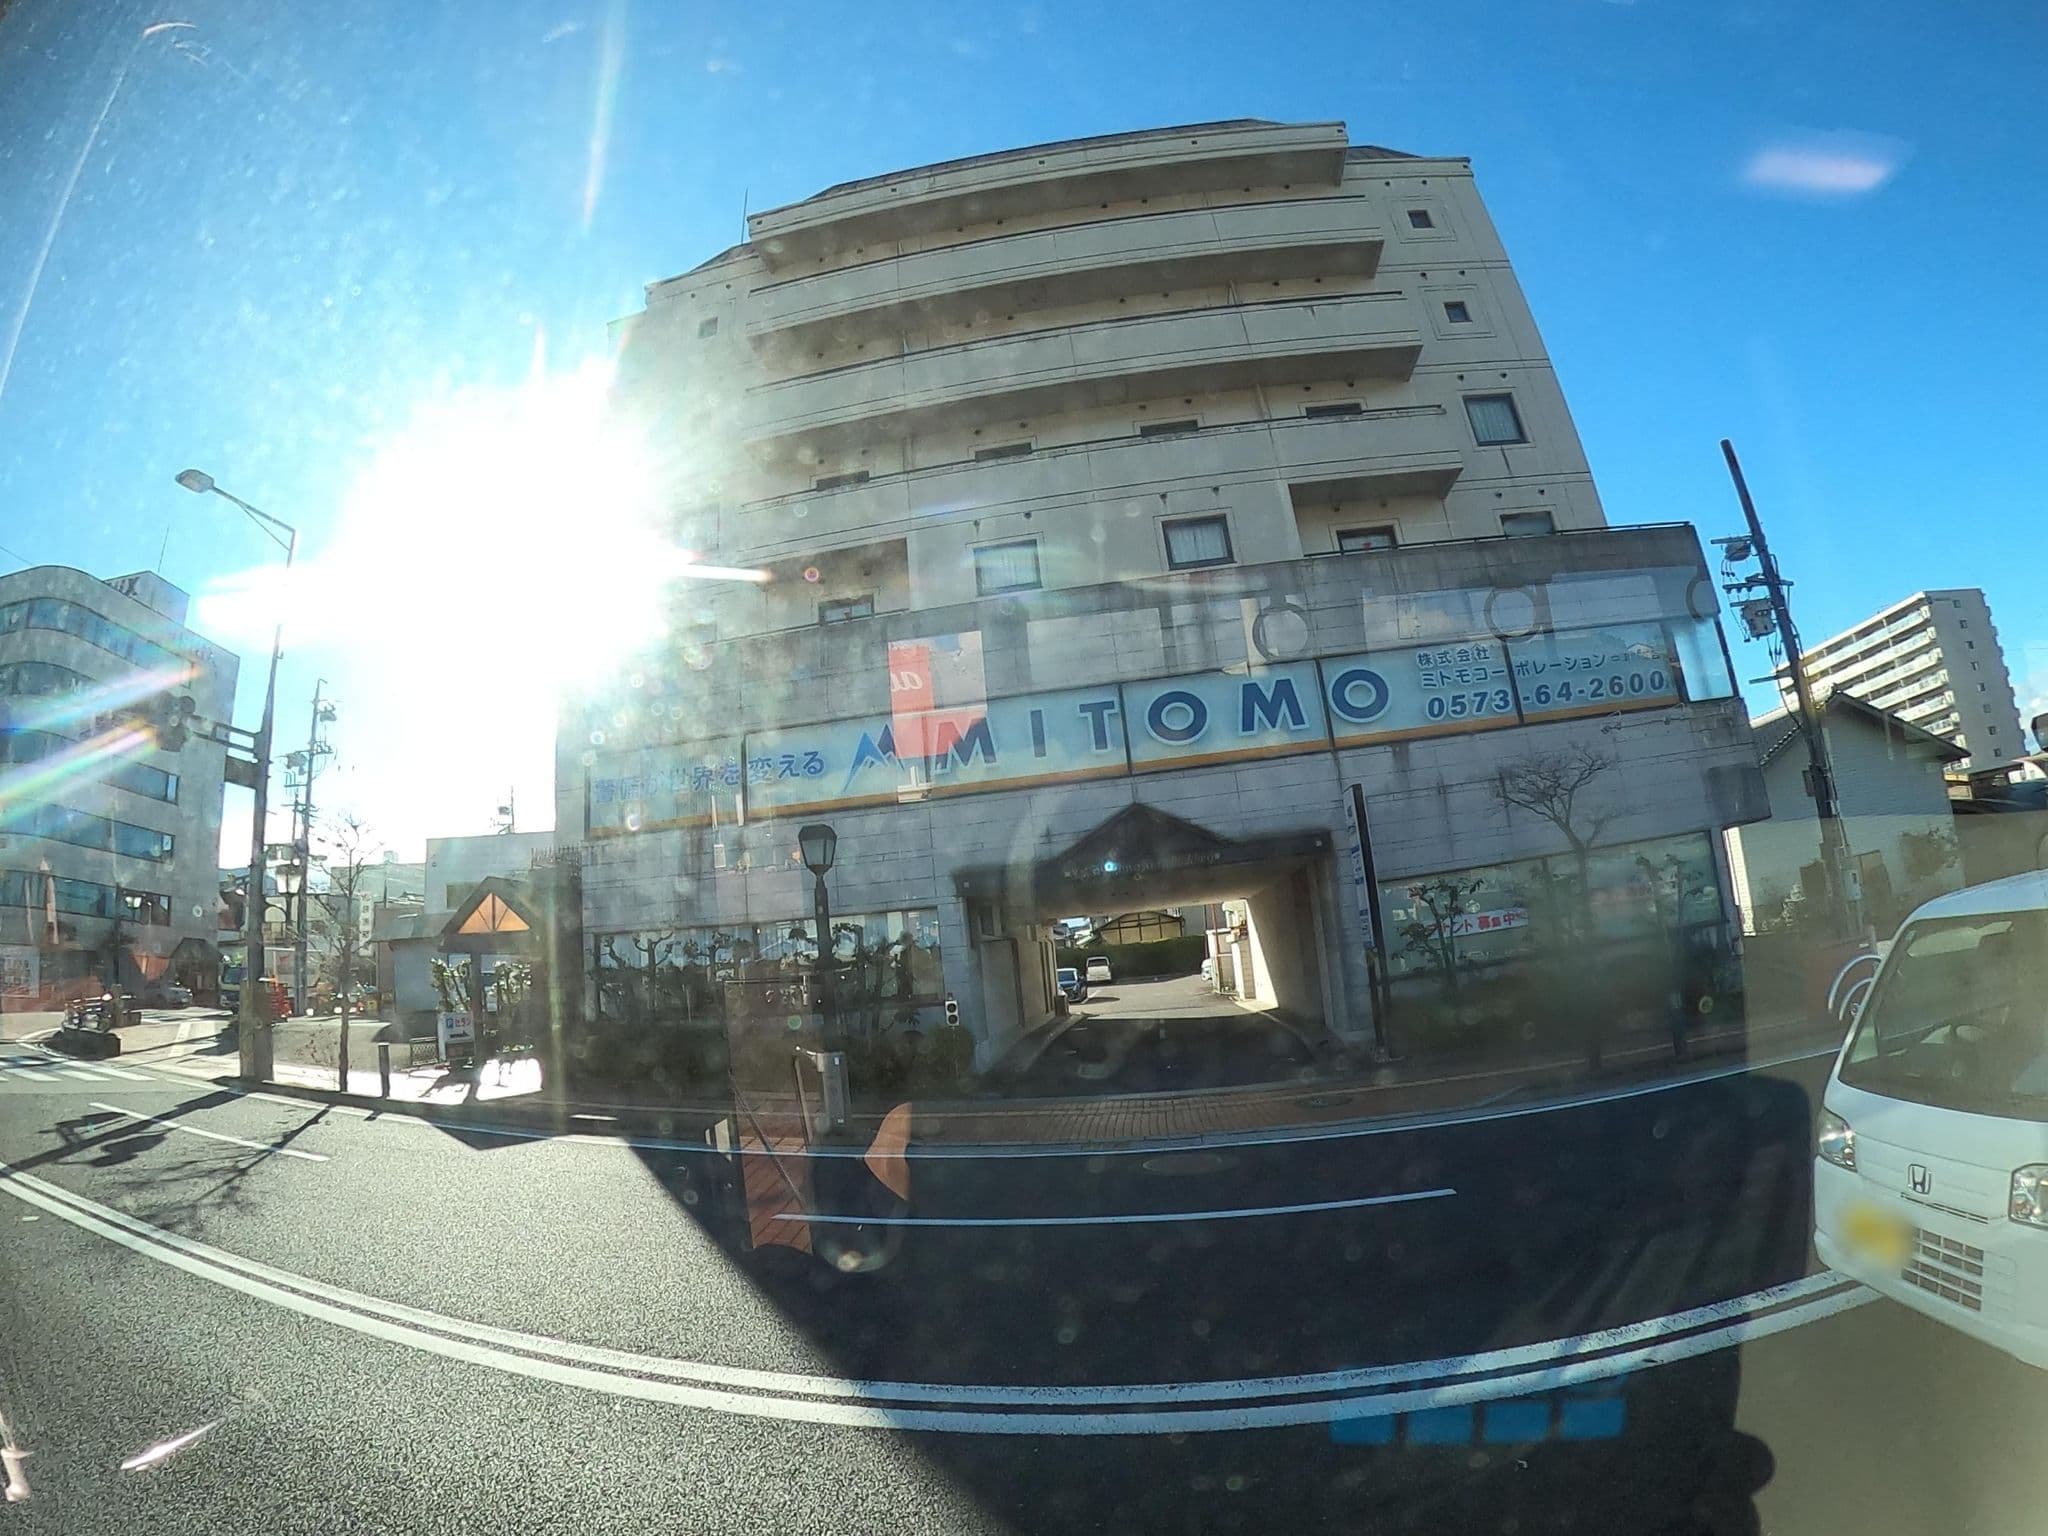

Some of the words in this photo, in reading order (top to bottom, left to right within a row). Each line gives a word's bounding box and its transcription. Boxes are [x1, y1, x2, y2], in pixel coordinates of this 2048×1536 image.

[1417, 647, 1491, 668] 株式会社
[1427, 670, 1665, 719] 0573-64-2600
